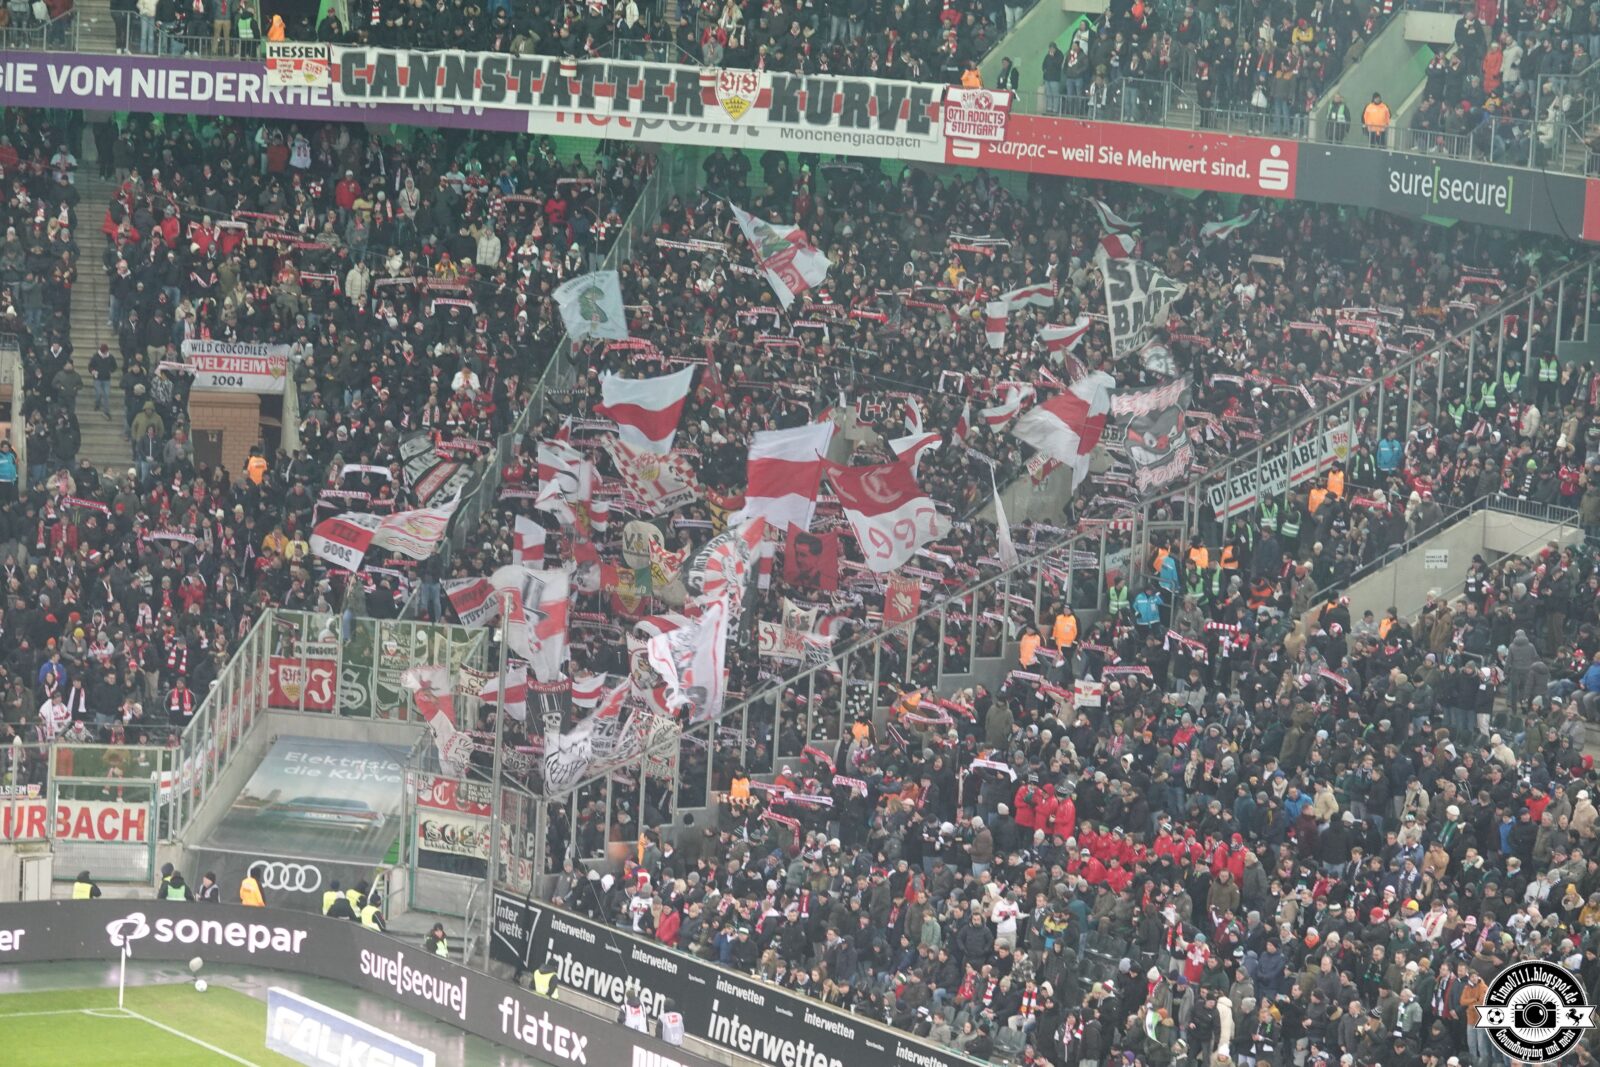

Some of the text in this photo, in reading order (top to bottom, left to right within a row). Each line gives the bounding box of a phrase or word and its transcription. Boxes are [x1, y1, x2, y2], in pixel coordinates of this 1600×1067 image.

[269, 46, 326, 58] HESSEN
[0, 62, 38, 93] IE
[47, 64, 122, 97] VOM
[341, 51, 704, 118] CANNSTATTER
[767, 75, 935, 135] KURVE
[948, 108, 1004, 125] 0711 ADDICTS
[951, 121, 998, 136] STUTTGART
[1061, 144, 1094, 163] weil
[1098, 146, 1123, 166] Sie
[1127, 150, 1207, 175] Mehrwert
[1211, 157, 1251, 179] sind.
[1388, 166, 1513, 214] sure[secure]
[191, 342, 268, 356] WILD CROCODILES
[191, 356, 266, 373] WELZHEIM
[211, 375, 243, 387] 2004
[851, 507, 939, 560] 1997
[284, 766, 401, 783] die Kurve
[496, 898, 519, 923] inter
[0, 918, 307, 953] er sonepar
[551, 914, 596, 945] interwetten
[632, 945, 678, 975] interwetten
[360, 949, 467, 1020] sure[secure]
[716, 975, 765, 1007] interwetten
[804, 1008, 855, 1040] interwetten
